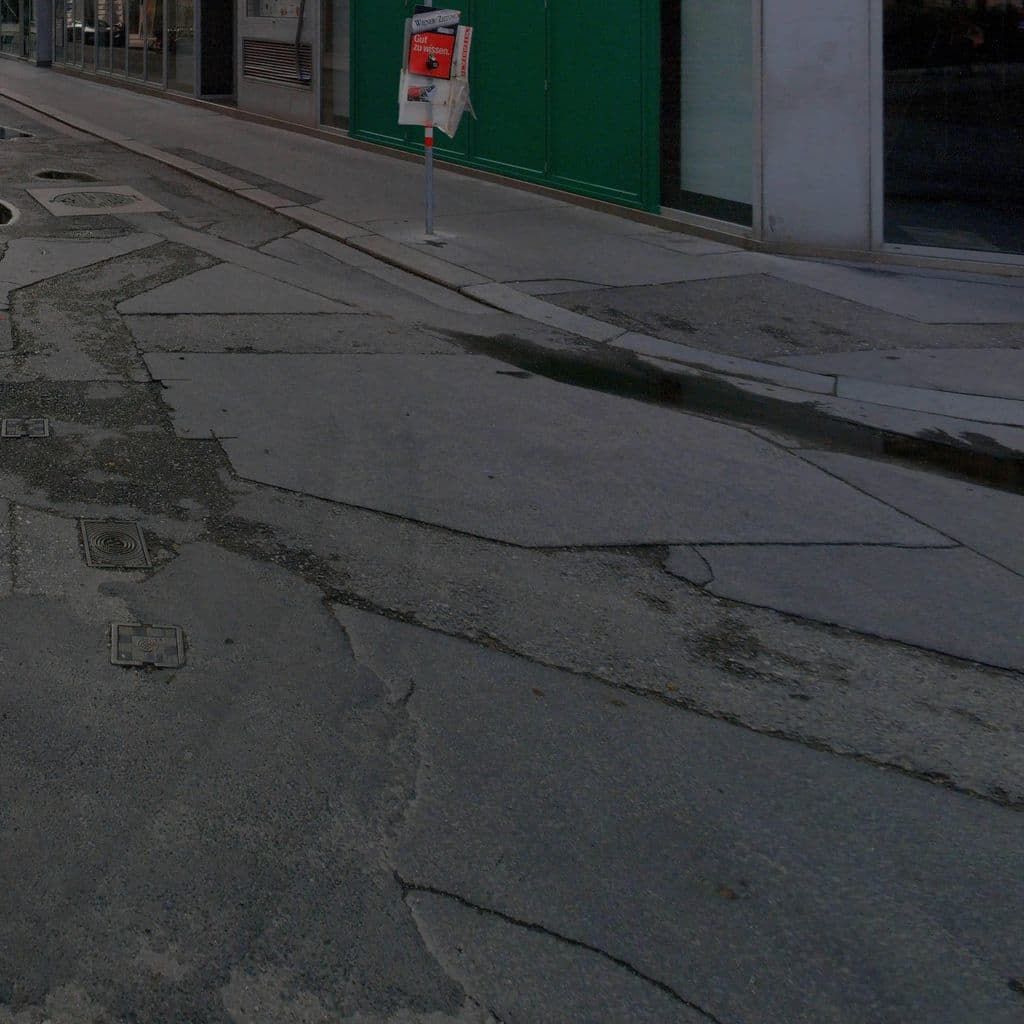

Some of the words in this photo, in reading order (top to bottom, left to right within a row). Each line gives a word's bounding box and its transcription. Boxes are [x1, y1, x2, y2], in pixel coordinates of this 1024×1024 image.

[414, 34, 428, 44] Gut
[413, 45, 422, 53] zu
[423, 46, 450, 56] wissen.
